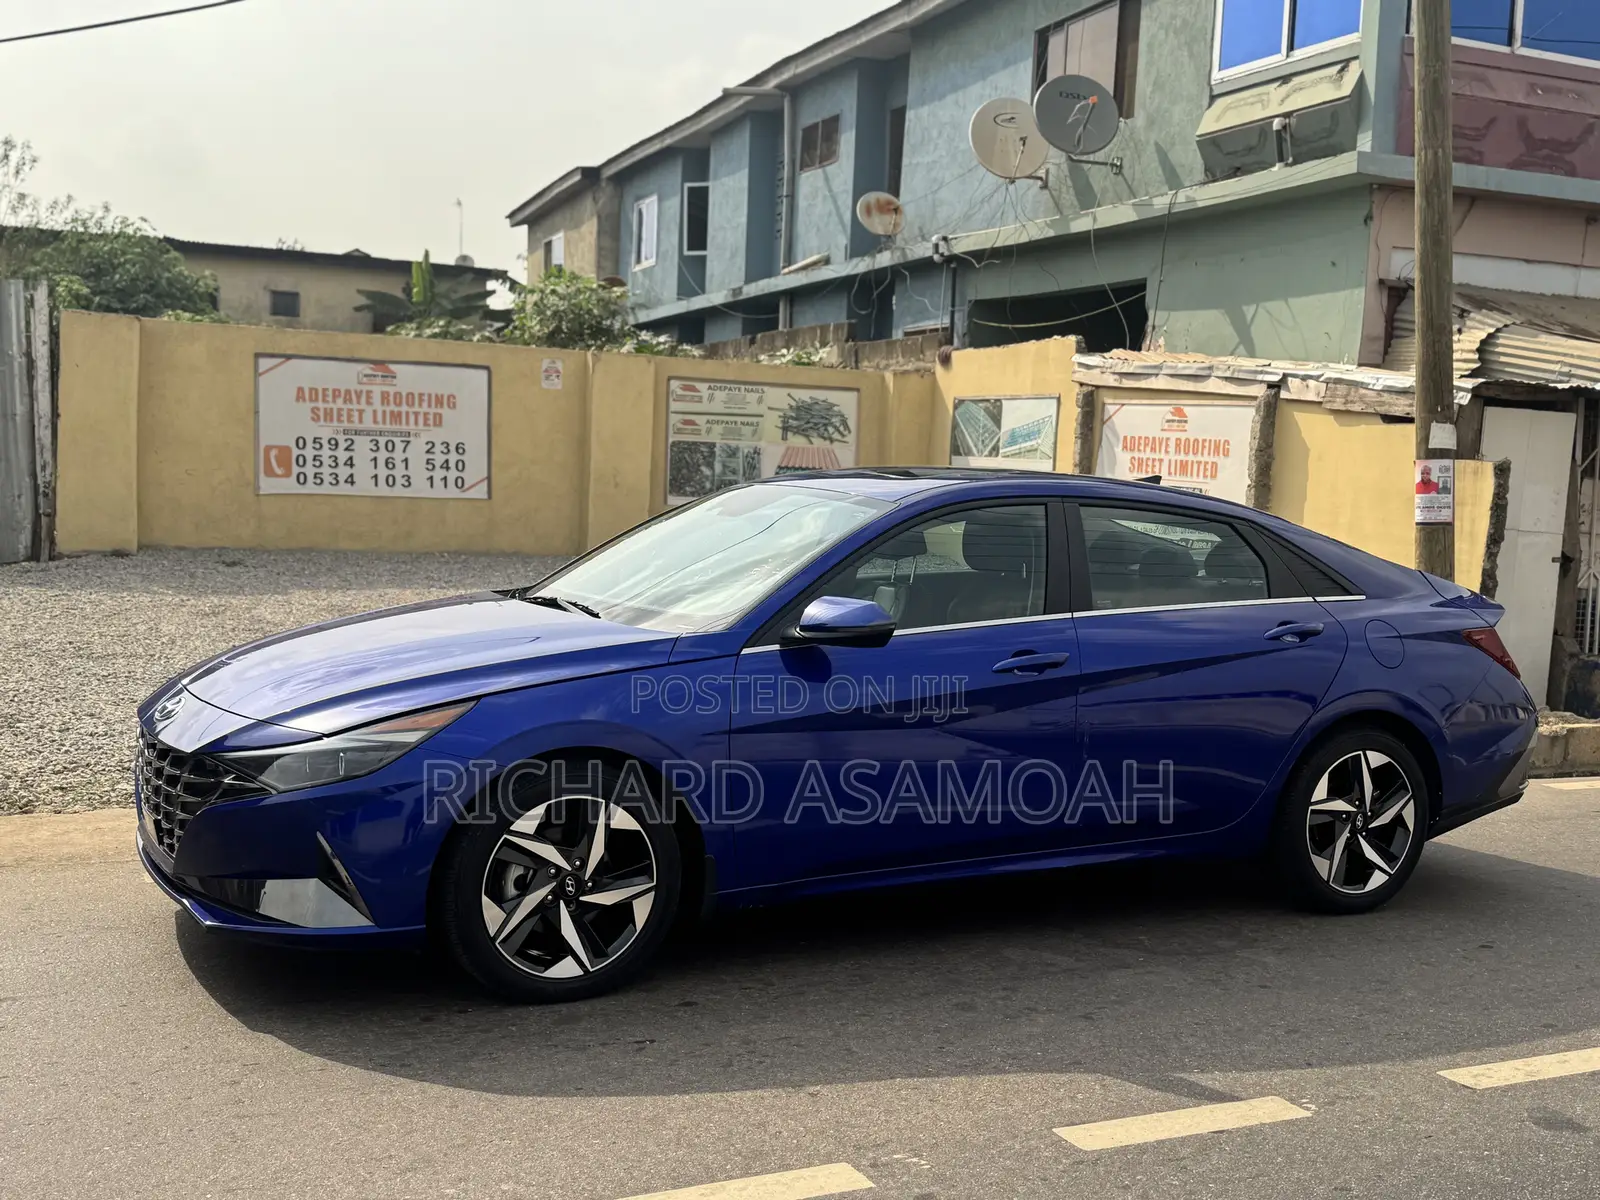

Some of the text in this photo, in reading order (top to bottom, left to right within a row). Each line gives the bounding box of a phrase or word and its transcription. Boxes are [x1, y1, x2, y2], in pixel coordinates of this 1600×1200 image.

[295, 387, 457, 409] ADEPAYE ROOFING
[310, 406, 443, 427] SHEET LIMITED
[705, 419, 738, 427] ADEPAYE
[295, 436, 466, 456] 0592 307 236
[1122, 435, 1230, 457] ADEPAYE ROOFING
[295, 454, 466, 473] 0534 161 540
[1128, 456, 1218, 479] SHEET LIMITED
[296, 472, 466, 490] 0534 103 110
